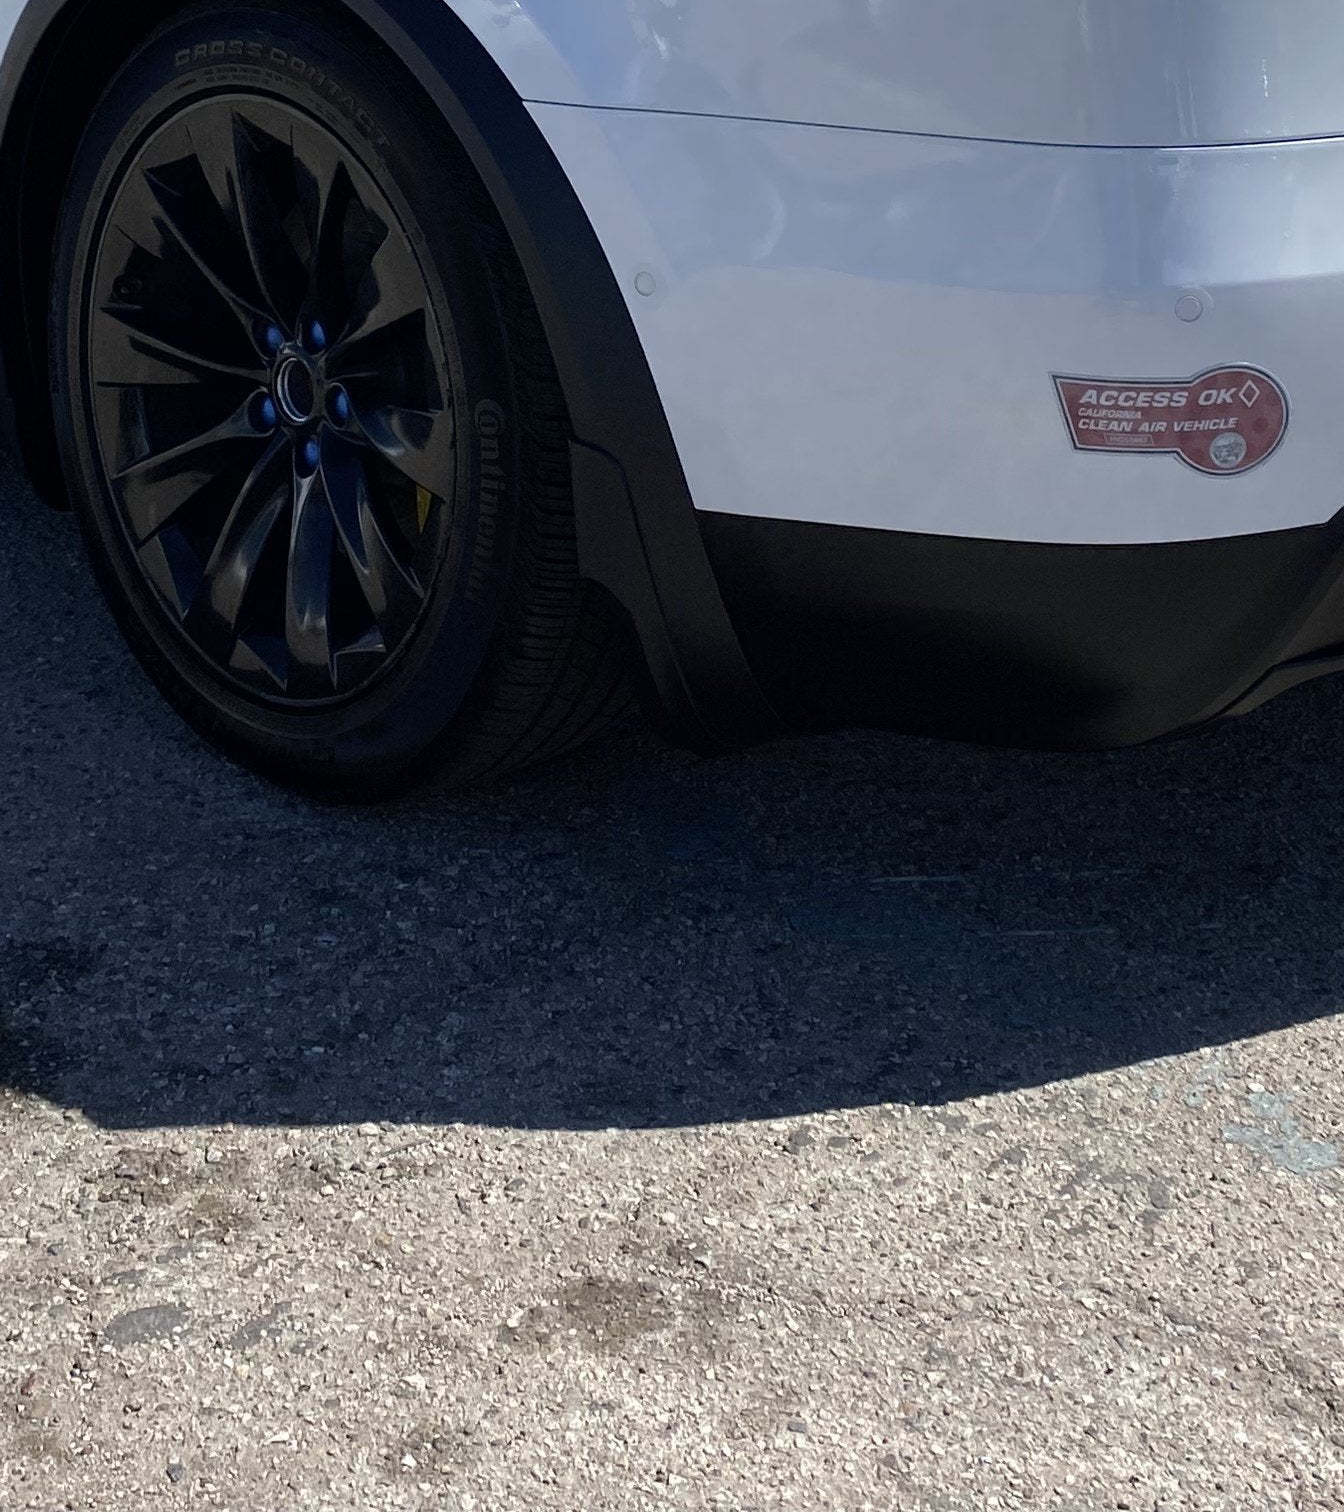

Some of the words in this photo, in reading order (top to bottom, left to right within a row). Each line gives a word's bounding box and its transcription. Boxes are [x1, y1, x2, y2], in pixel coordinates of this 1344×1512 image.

[1079, 389, 1189, 408] ACCESS
[1197, 387, 1238, 406] OK
[1077, 408, 1142, 419] CALIFORNIA
[1077, 418, 1133, 432] CLEAN
[1138, 421, 1167, 432] AIR
[1173, 417, 1239, 432] VEHICLE
